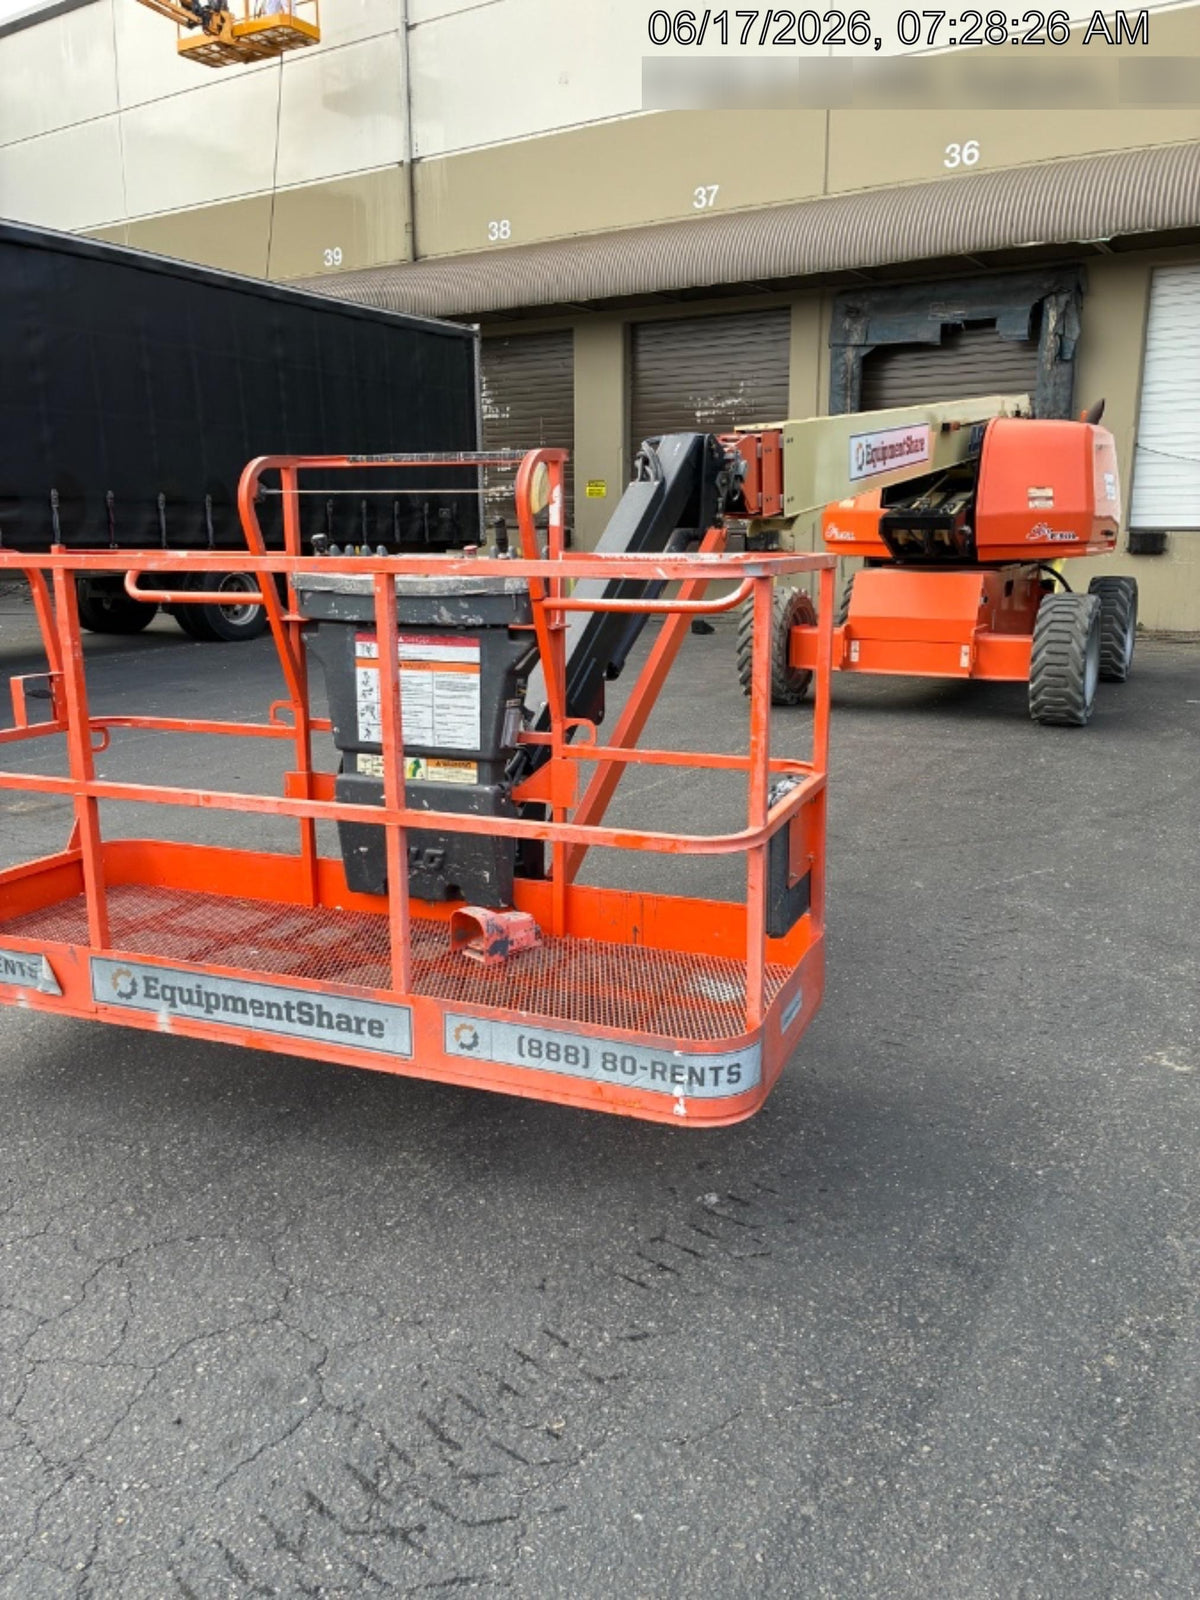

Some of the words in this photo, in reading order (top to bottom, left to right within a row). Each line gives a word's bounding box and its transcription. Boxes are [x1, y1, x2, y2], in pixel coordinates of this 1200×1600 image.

[943, 140, 980, 168] 36
[692, 184, 720, 209] 37
[488, 219, 511, 241] 38
[323, 247, 343, 266] 39
[865, 434, 926, 469] EquipmentShare
[142, 975, 386, 1039] EquipmentShare
[517, 1034, 590, 1070] (888)
[602, 1051, 742, 1088] 80-RENTS
